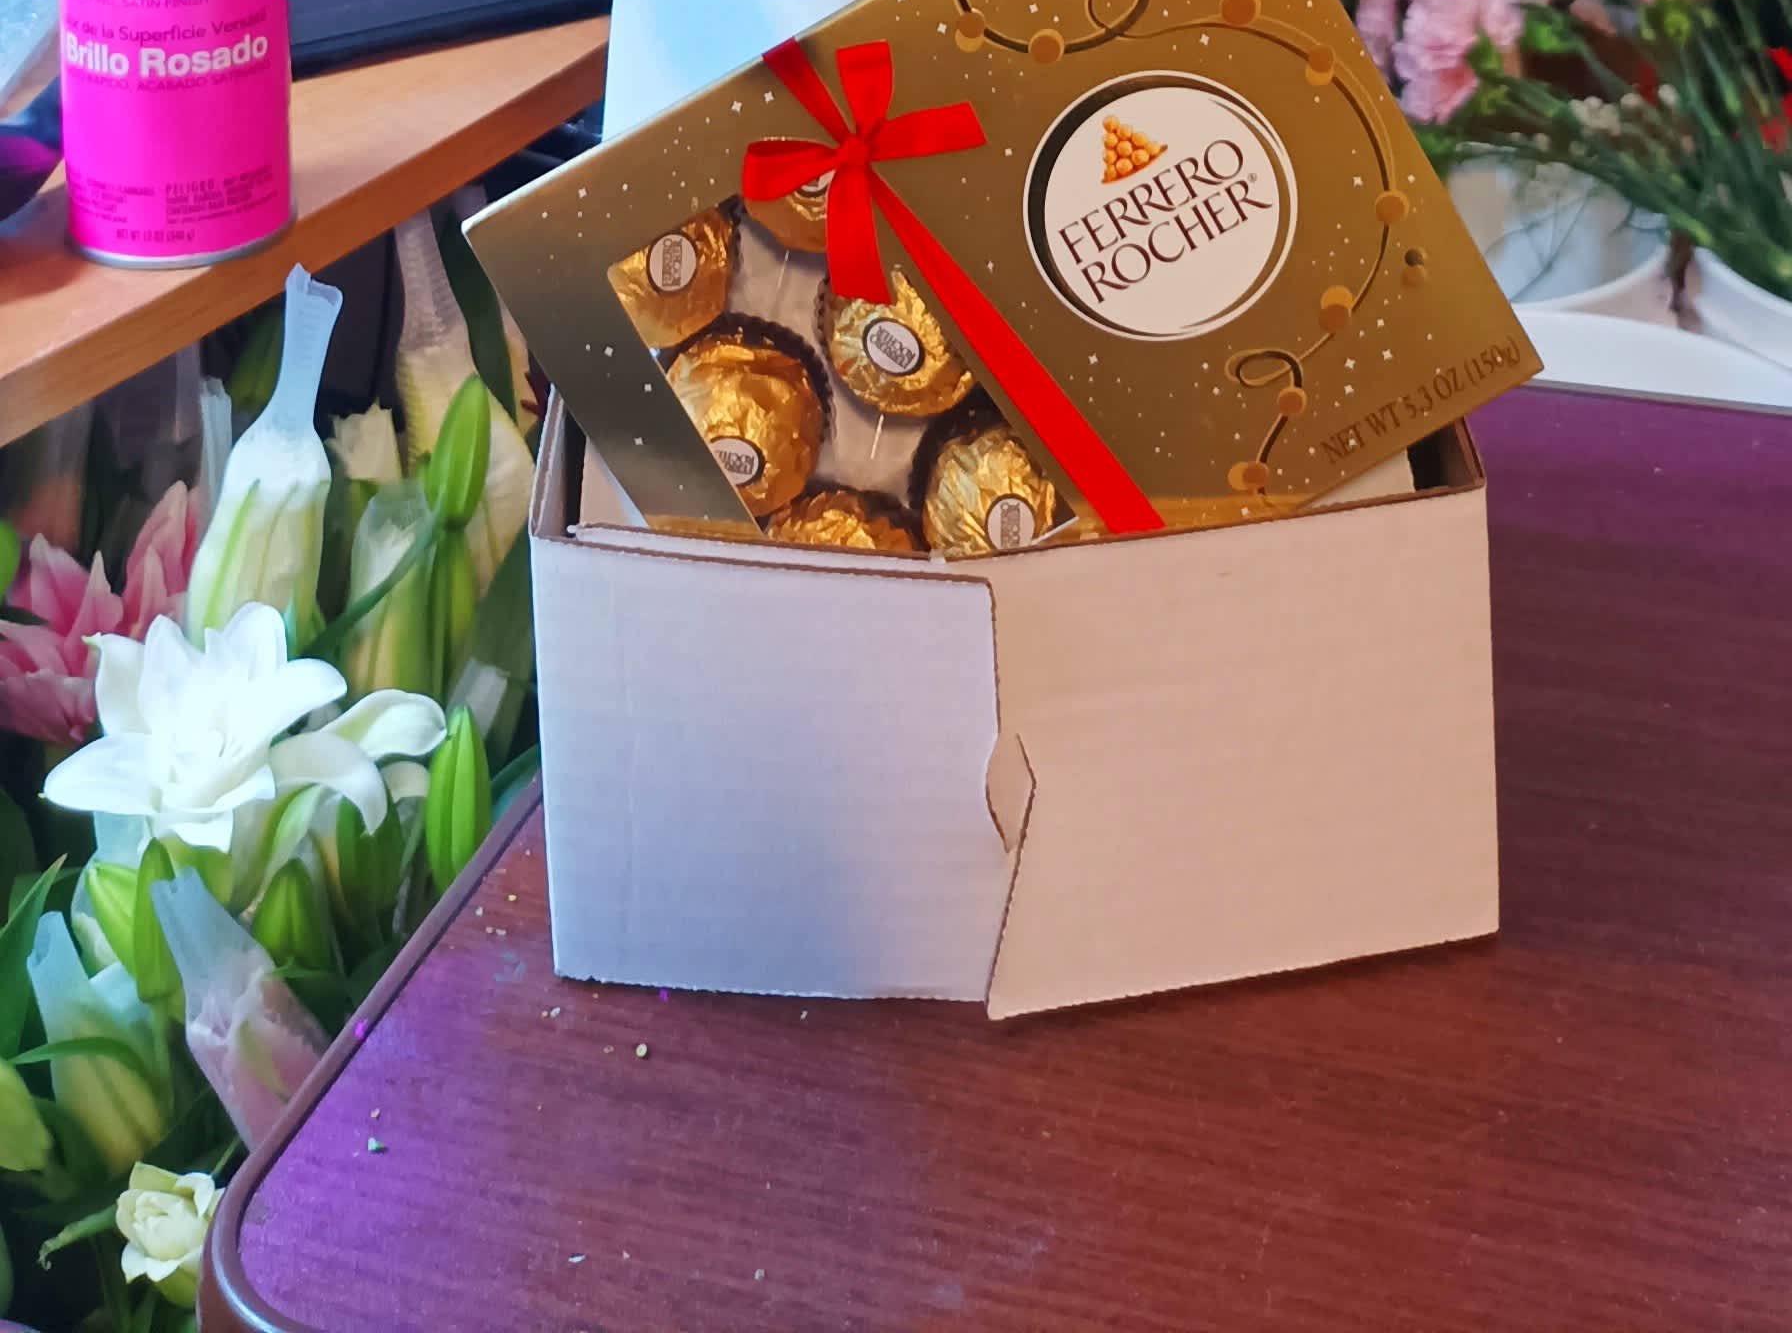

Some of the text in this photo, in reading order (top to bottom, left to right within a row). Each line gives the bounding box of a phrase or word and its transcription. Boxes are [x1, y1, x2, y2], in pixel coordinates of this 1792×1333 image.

[66, 31, 269, 78] Brillo Rosado
[119, 24, 207, 45] Superficie
[1058, 139, 1244, 265] FERRERO
[1081, 180, 1273, 304] ROCHER
[1320, 335, 1521, 465] NET WT 5.3 OZ (150g)
